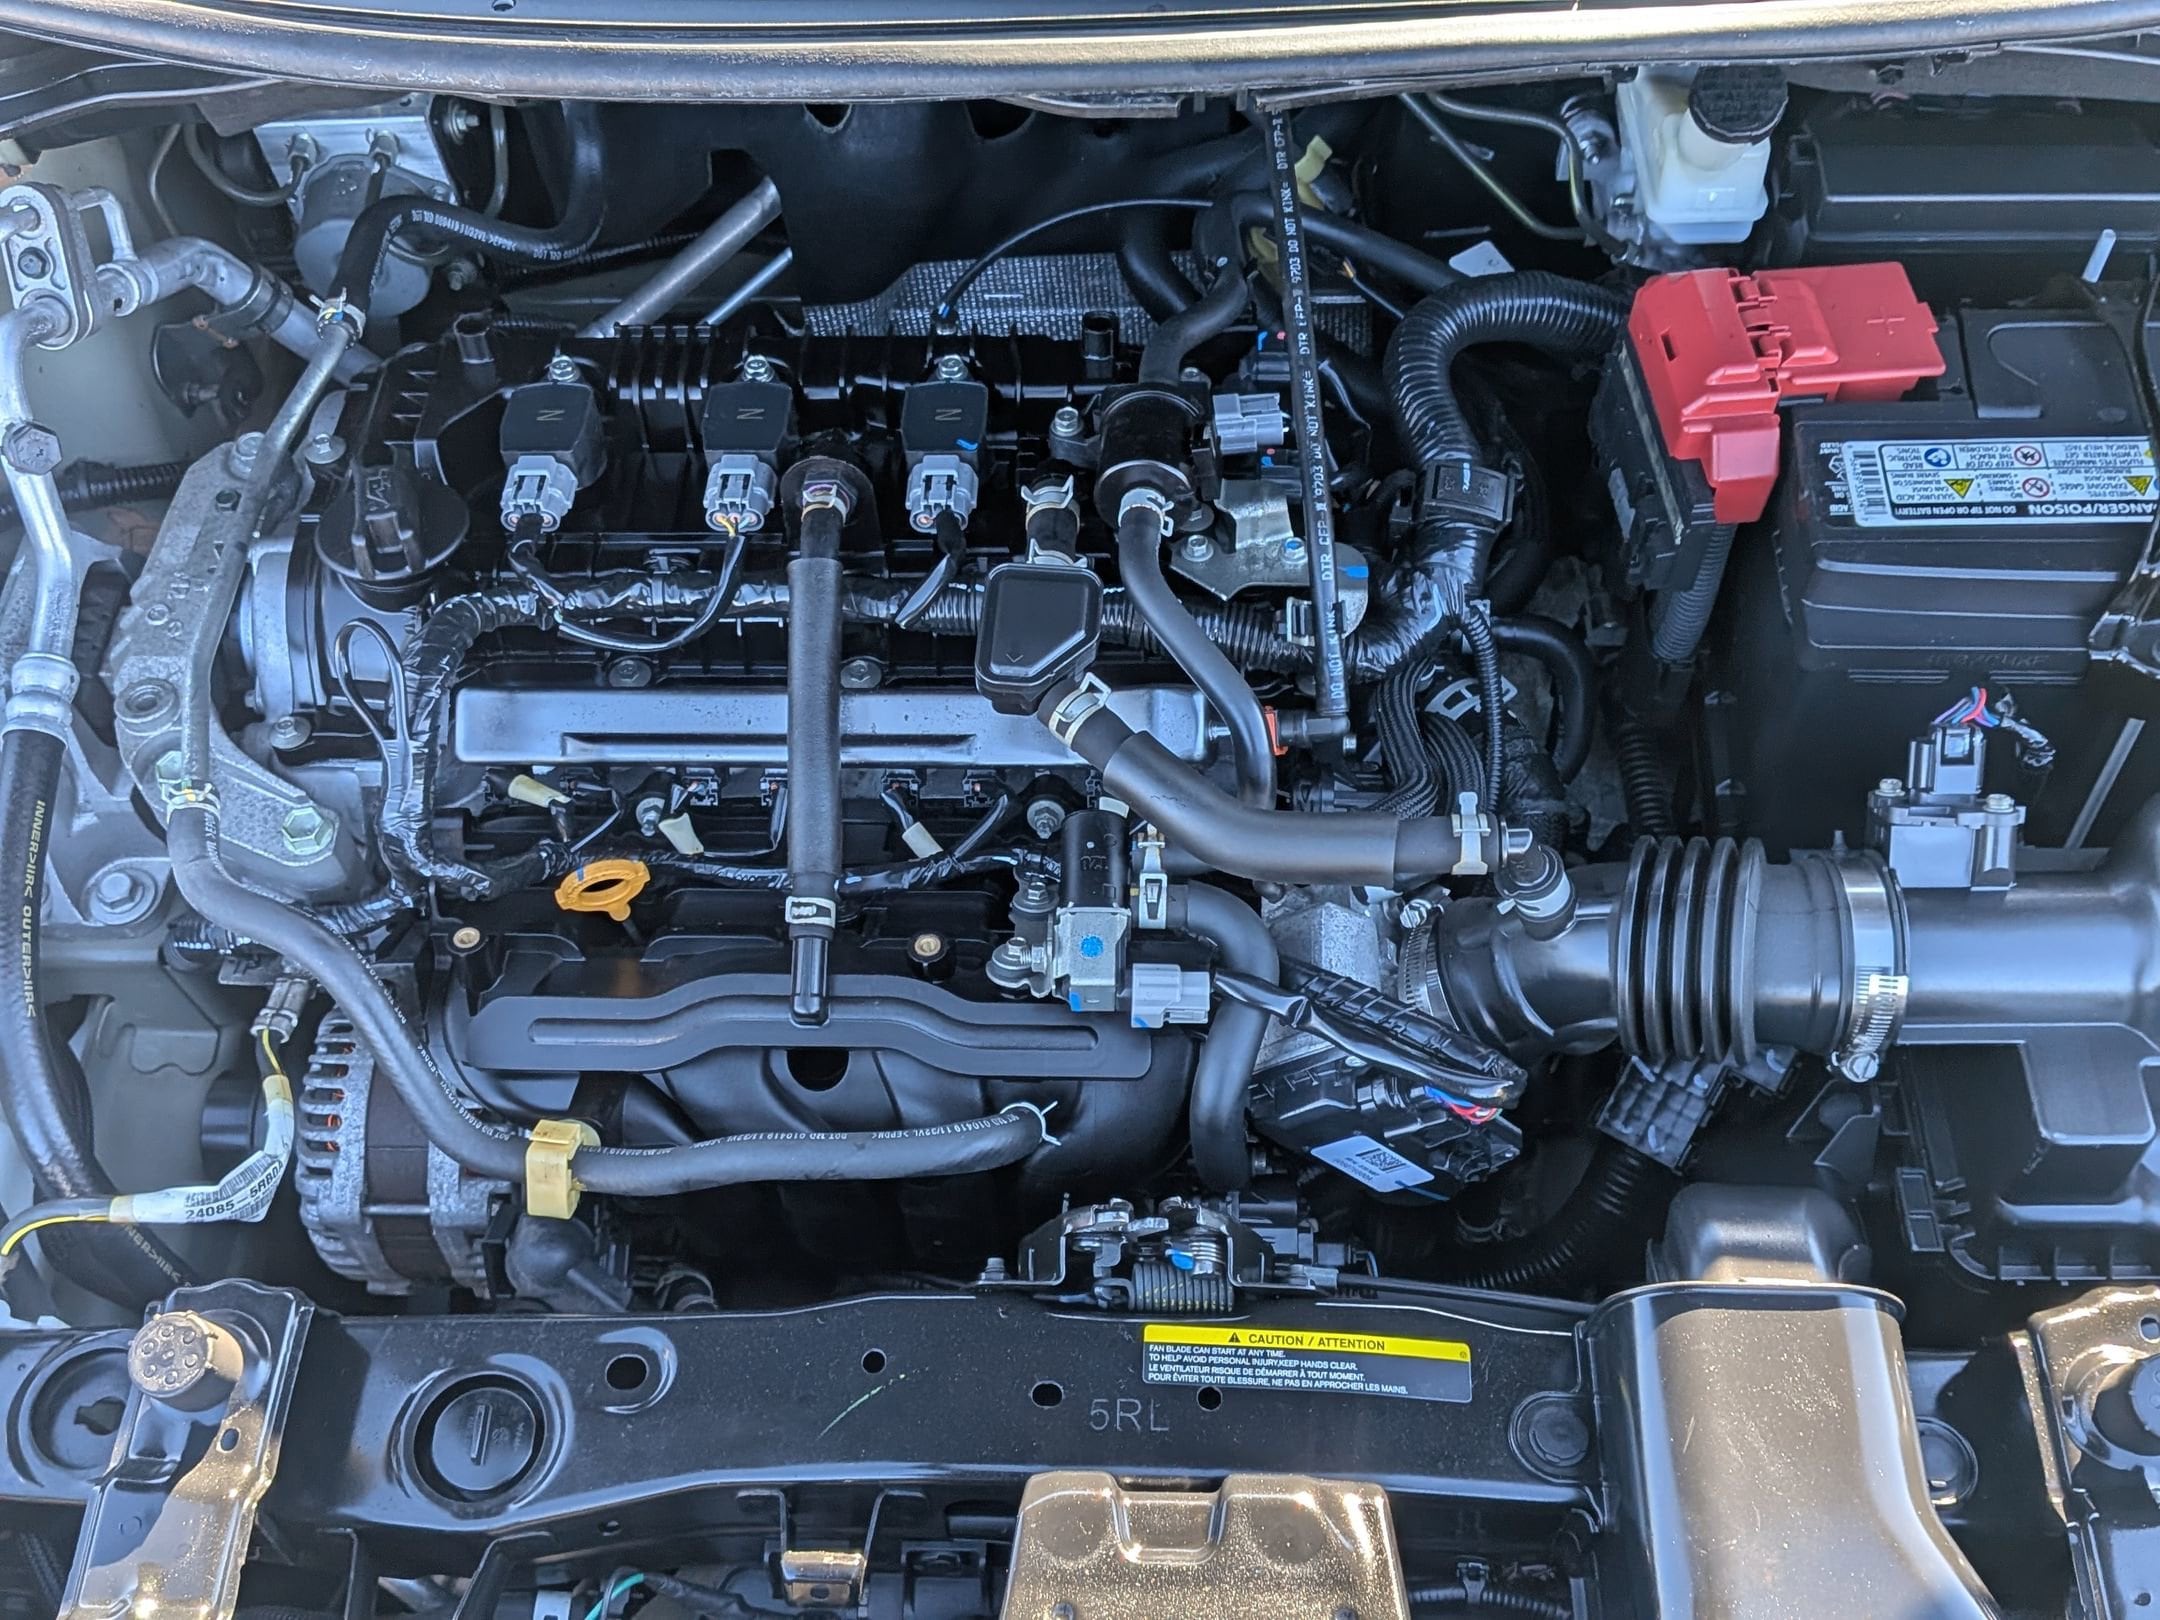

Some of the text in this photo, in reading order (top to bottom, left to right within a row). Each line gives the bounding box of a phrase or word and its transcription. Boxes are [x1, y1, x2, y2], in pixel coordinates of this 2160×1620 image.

[1276, 151, 1288, 170] DTR
[1284, 217, 1297, 236] NOT
[1287, 239, 1299, 253] DO
[1289, 257, 1302, 284] 9703
[1297, 332, 1310, 355] DTR
[1311, 464, 1324, 498] 9703
[1933, 507, 1956, 515] OPEN
[1956, 507, 1969, 515] OR
[1970, 506, 1983, 515] TIP
[2028, 503, 2157, 515] ANGER/POISON
[1320, 553, 1334, 581] DTR
[1149, 1344, 1286, 1358] FAN BLADE CAN START AT ANY TIME.
[1248, 1333, 1303, 1345] CAUTION
[1317, 1336, 1385, 1351] ATTENTION
[1149, 1353, 1160, 1361] TO
[1161, 1354, 1182, 1362] HELP
[1183, 1355, 1205, 1363] AVOID
[1208, 1356, 1250, 1366] PERSONAL
[1301, 1359, 1329, 1369] HANDS
[1330, 1361, 1358, 1370] CLEAR.
[1149, 1363, 1158, 1371] LE
[1159, 1364, 1210, 1374] VENTILATEUR
[1211, 1366, 1241, 1375] RISQUE
[1243, 1367, 1254, 1376] DE
[1255, 1366, 1299, 1378] DÉMARRER
[1307, 1371, 1327, 1379] TOUT
[1329, 1372, 1366, 1382] MOMENT.
[1148, 1373, 1409, 1394] POUR ÉVITER TOUTE BLESSURE, NE PAS EN APPROCHER LES MAINS.
[1090, 1398, 1169, 1431] 5RL
